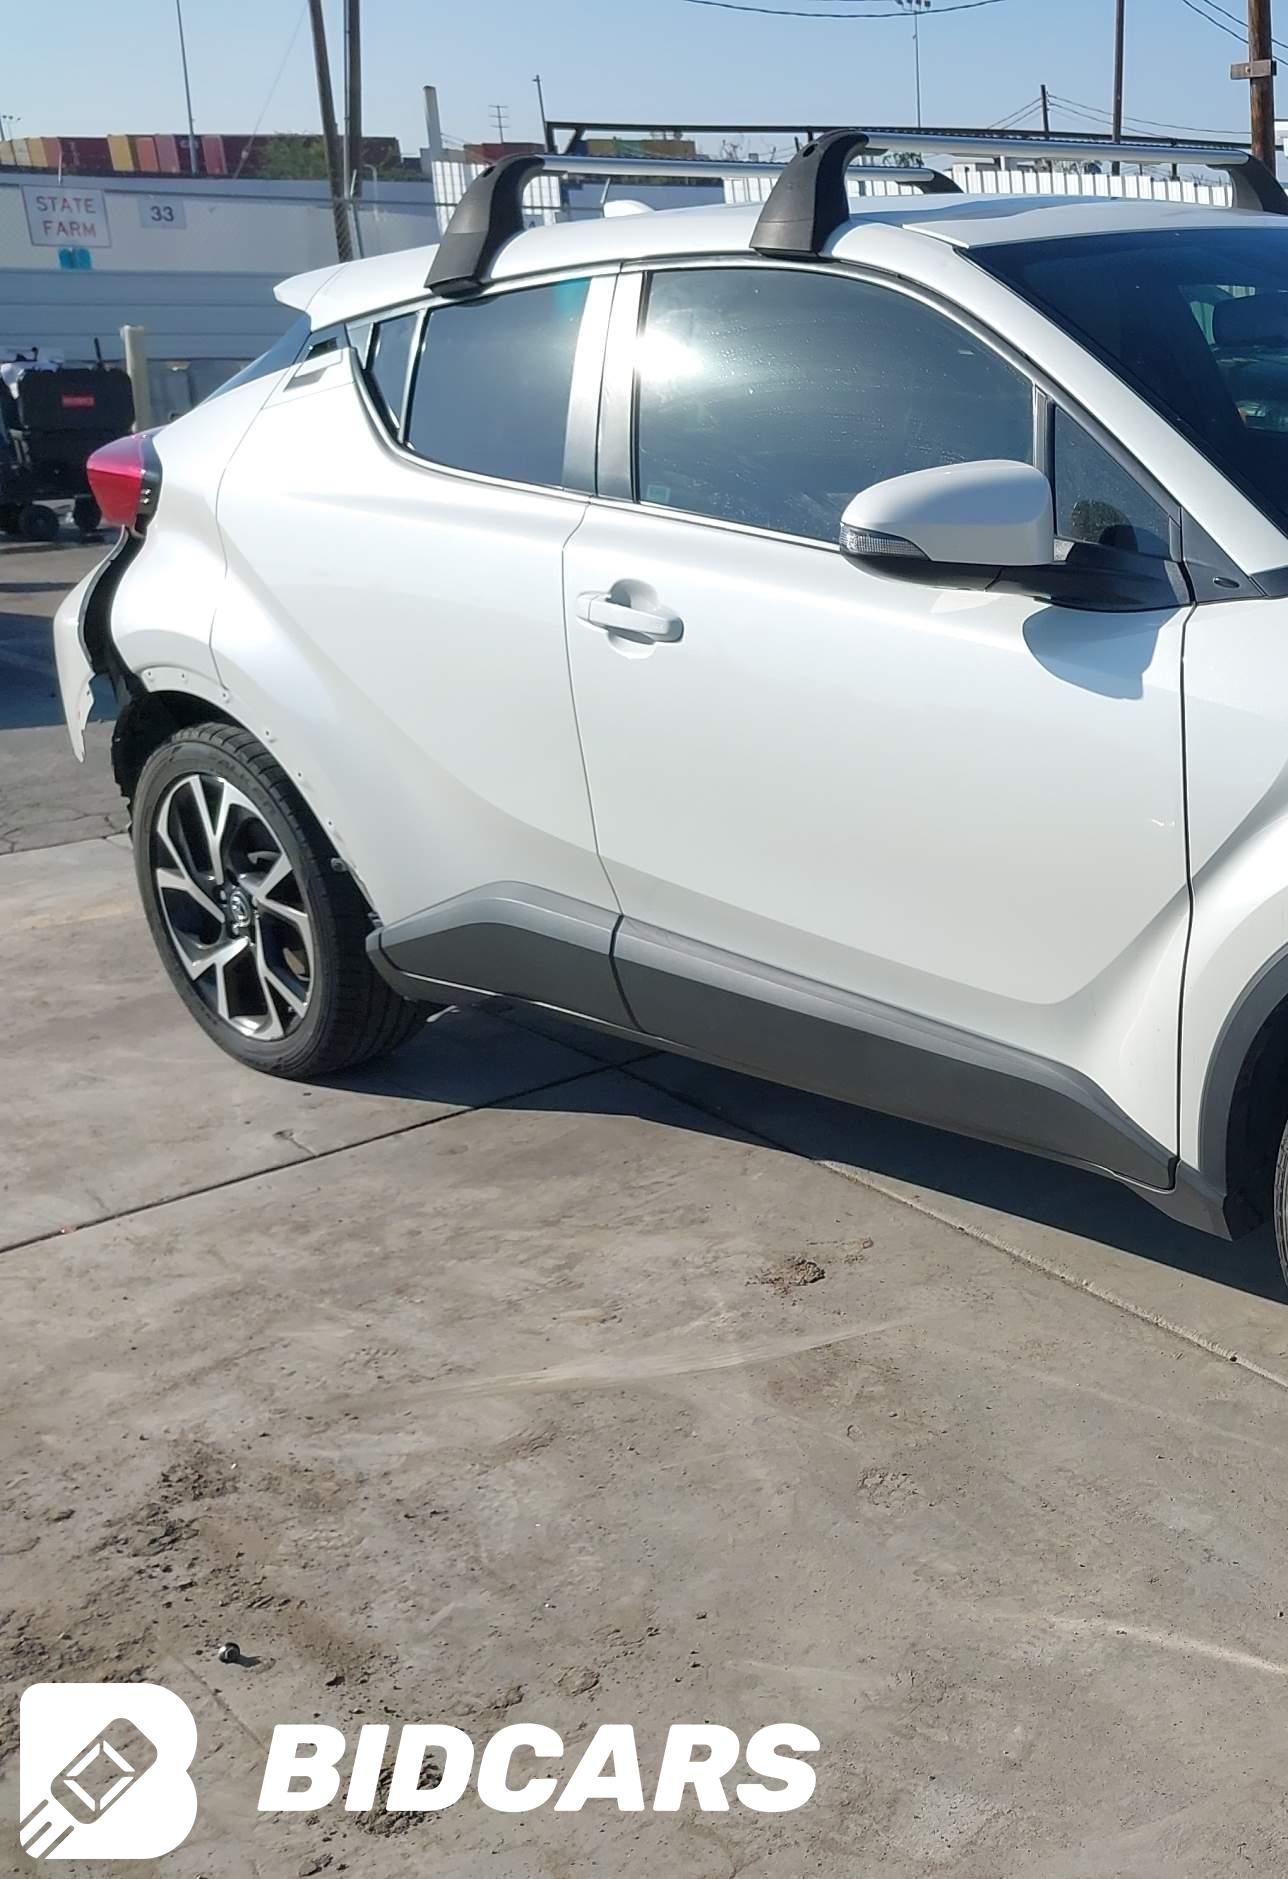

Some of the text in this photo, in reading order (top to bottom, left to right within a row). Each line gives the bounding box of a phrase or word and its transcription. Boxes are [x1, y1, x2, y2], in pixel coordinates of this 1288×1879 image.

[36, 196, 96, 214] STATE
[150, 206, 174, 222] 33
[42, 220, 97, 238] FARM
